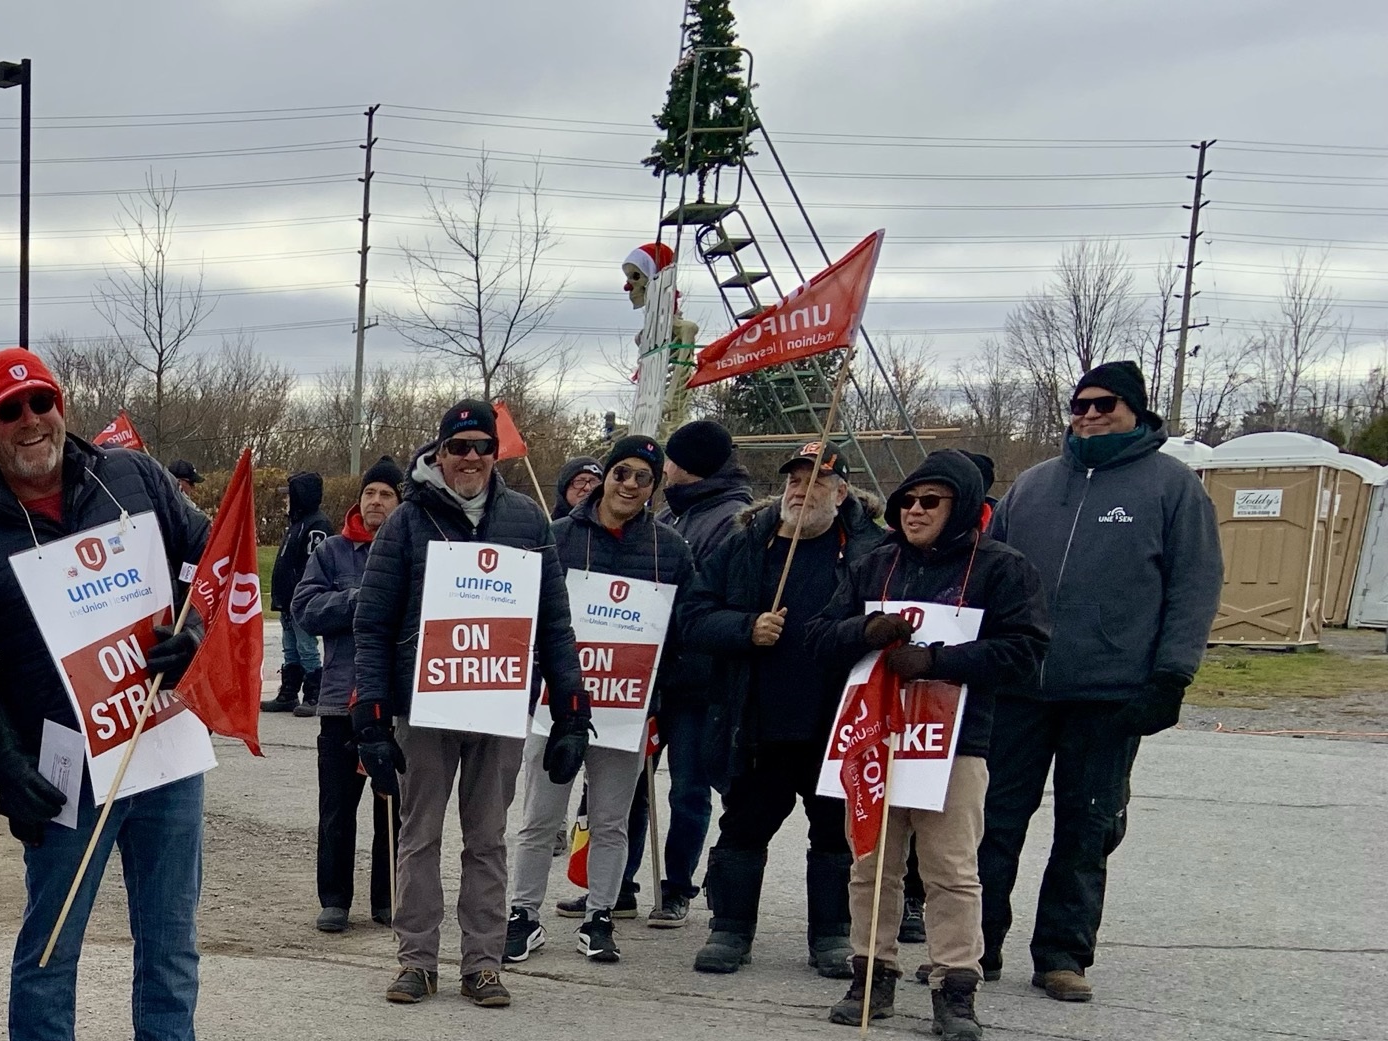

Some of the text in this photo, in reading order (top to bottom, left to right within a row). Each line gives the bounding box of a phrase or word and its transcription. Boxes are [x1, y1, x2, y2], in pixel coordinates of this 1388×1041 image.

[451, 623, 490, 652] ON
[97, 633, 148, 684] ON
[426, 656, 522, 686] STRIKE
[578, 647, 614, 672] ON
[581, 677, 643, 703] RIKE
